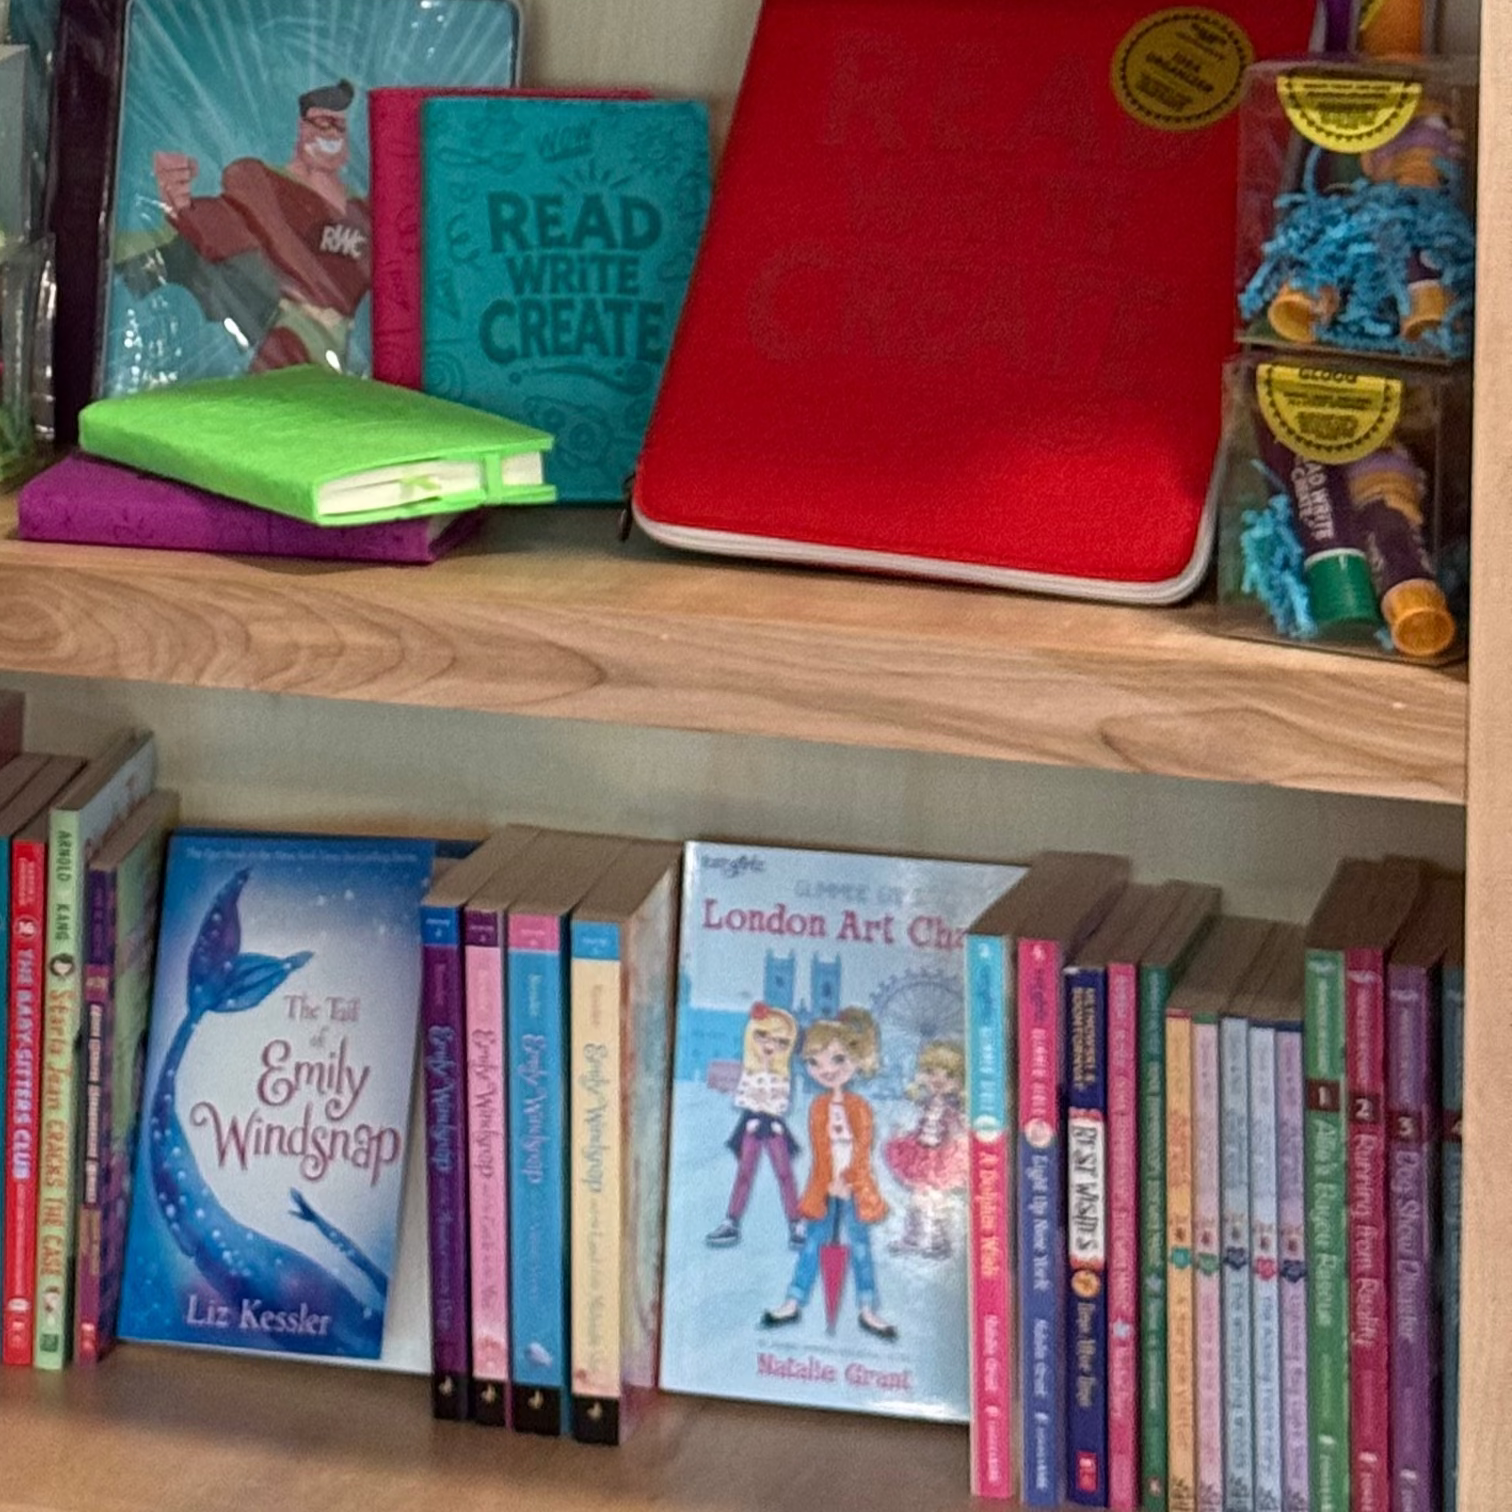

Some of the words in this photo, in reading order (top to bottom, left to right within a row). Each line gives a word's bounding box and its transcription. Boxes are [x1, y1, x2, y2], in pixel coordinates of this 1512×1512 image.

[488, 190, 663, 254] READ
[479, 297, 666, 365] CREATE
[55, 830, 73, 883] ARNOLD
[54, 902, 73, 941] KANG
[701, 897, 828, 938] London
[837, 909, 896, 945] Art
[16, 948, 35, 984] THE
[49, 990, 71, 1056] Starla
[284, 993, 322, 1021] The
[14, 989, 34, 1125] BABY-SITTERS
[310, 1026, 330, 1048] of
[426, 1024, 457, 1078] Emily
[471, 1028, 498, 1079] Emily
[518, 1033, 548, 1087] Emily
[41, 1065, 72, 1110] Jean
[257, 1038, 371, 1122] Emily
[579, 1042, 610, 1096] Emily
[1318, 1085, 1331, 1109] 1
[1354, 1097, 1374, 1121] 2
[189, 1101, 403, 1188] Windsnap
[428, 1080, 457, 1174] Windsnap
[472, 1082, 503, 1180] Windsnap
[521, 1088, 549, 1185] Windsnap
[581, 1096, 609, 1194] Windsnap
[1070, 1125, 1098, 1178] BEST
[1397, 1115, 1417, 1137] 3
[12, 1128, 32, 1180] CLUB
[45, 1118, 69, 1188] CRACKS
[1350, 1133, 1378, 1218] Running
[1390, 1148, 1420, 1194] Dog
[43, 1197, 67, 1227] THE
[1072, 1181, 1099, 1251] WISHES
[1396, 1197, 1421, 1250] Show
[40, 1234, 65, 1276] CASE
[188, 1294, 229, 1328] Liz
[239, 1298, 333, 1336] Kessler
[1314, 1252, 1339, 1328] Rescue
[1351, 1276, 1385, 1349] Reality
[1396, 1258, 1422, 1343] Disaster
[756, 1351, 838, 1385] Natalie
[844, 1361, 916, 1392] Grant
